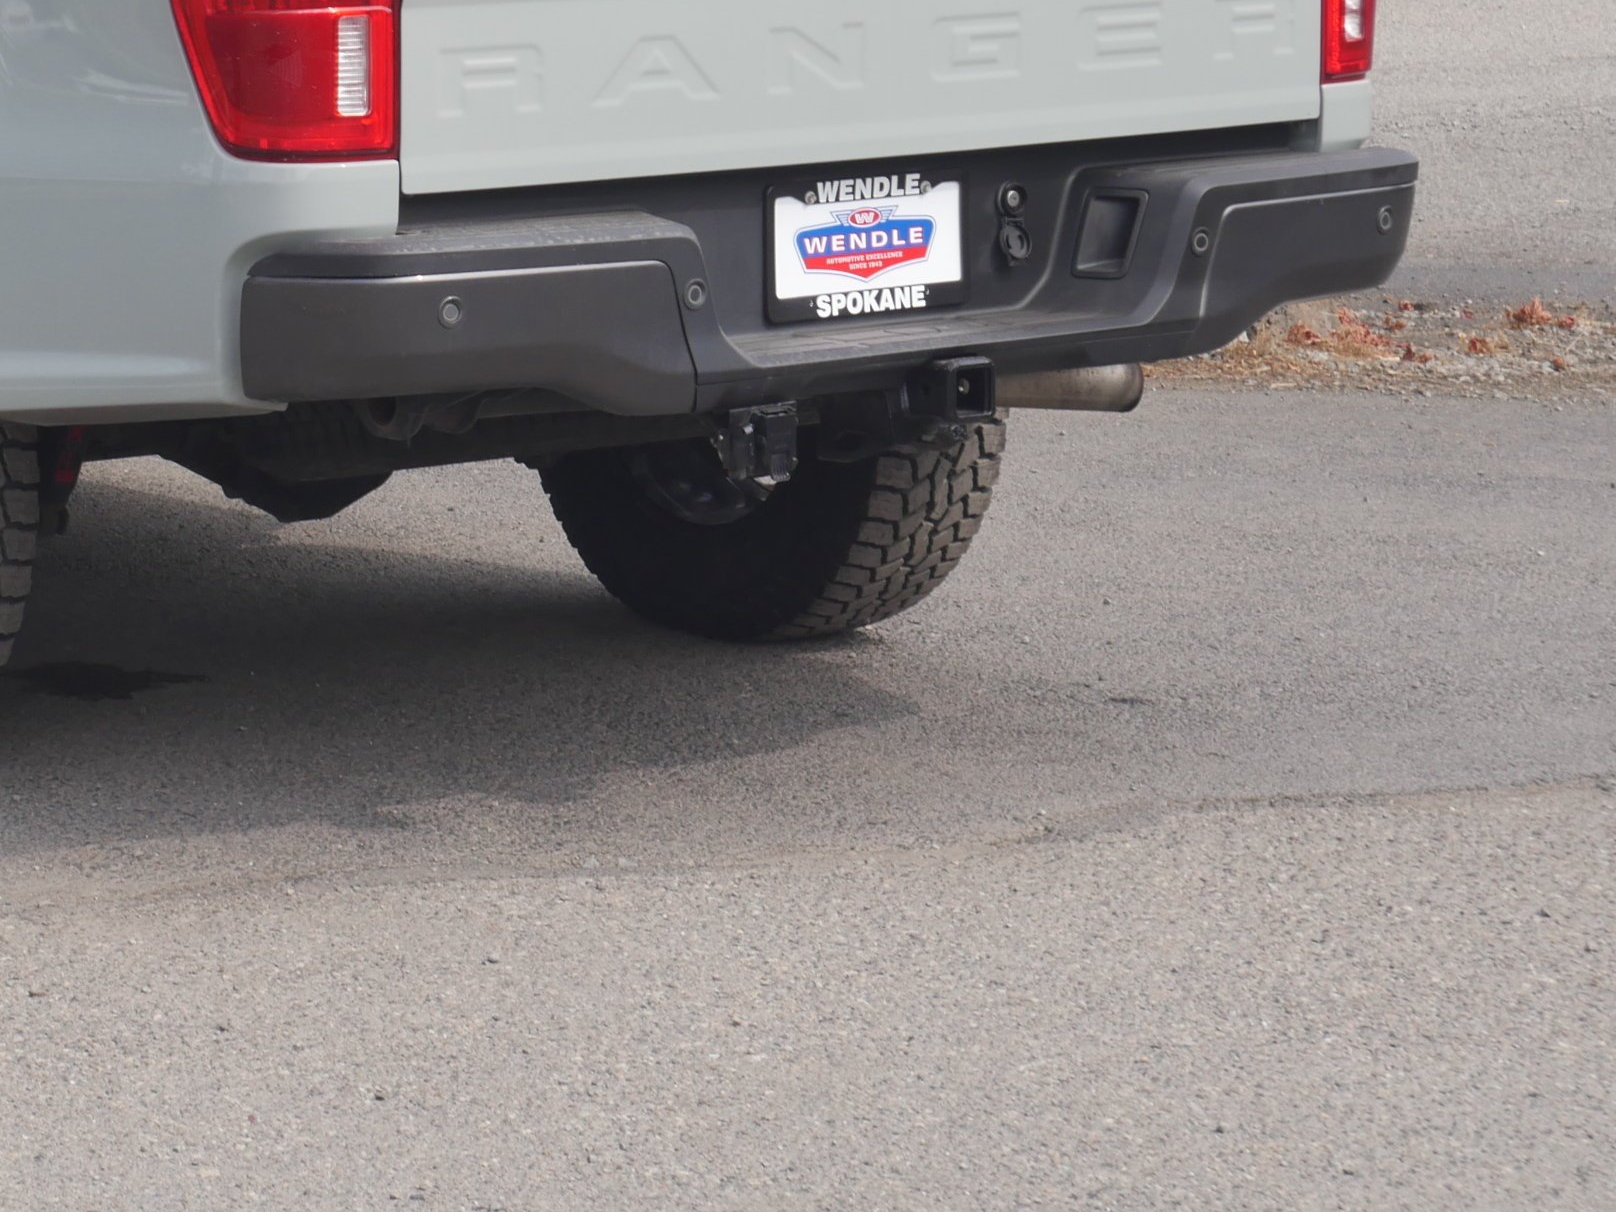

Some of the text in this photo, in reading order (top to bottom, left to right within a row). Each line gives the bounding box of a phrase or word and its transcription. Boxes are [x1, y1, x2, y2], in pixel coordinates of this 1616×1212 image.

[816, 173, 921, 204] WENDLE
[804, 227, 923, 254] WENDLE
[827, 251, 903, 264] AUTOMOTIVE EXCELLENCE
[817, 285, 926, 318] SPOKANE
